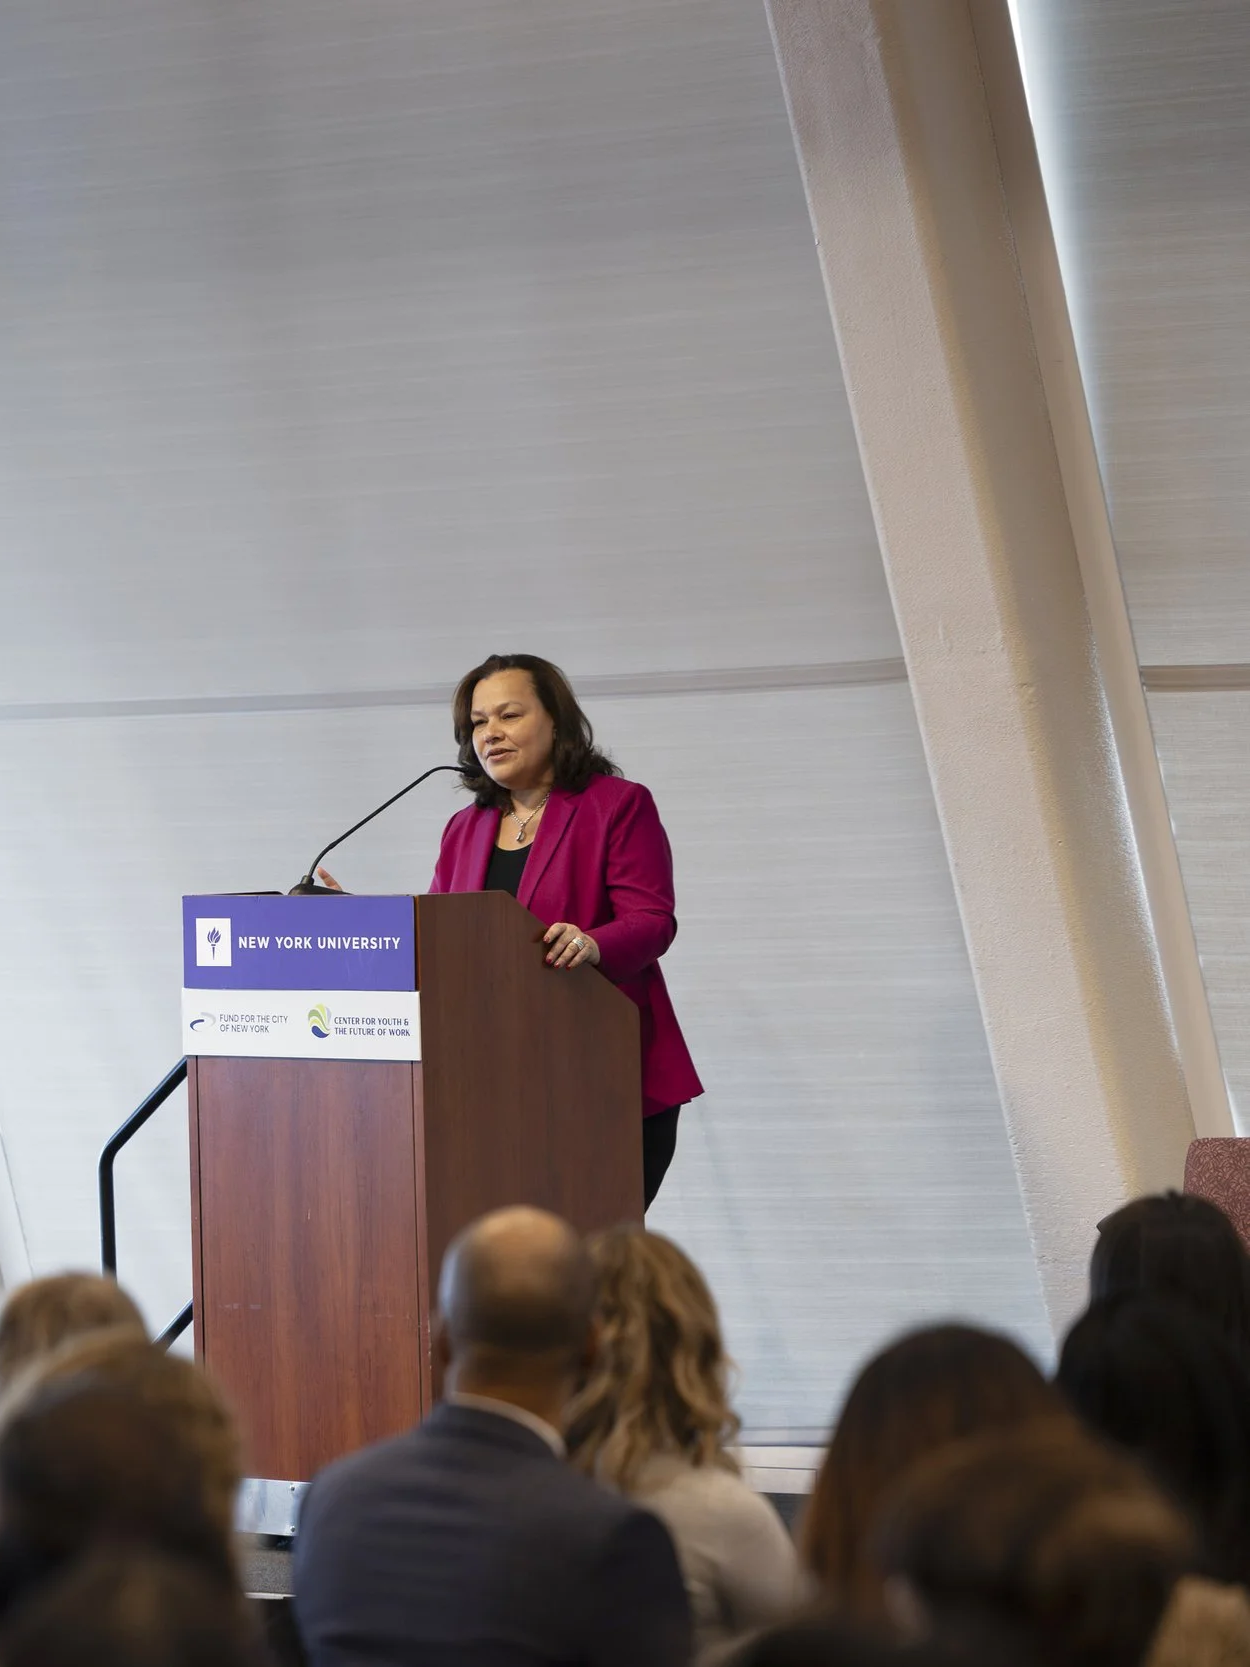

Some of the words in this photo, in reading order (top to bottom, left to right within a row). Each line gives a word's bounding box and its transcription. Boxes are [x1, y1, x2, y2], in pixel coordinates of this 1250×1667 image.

[238, 936, 270, 949] NEW
[275, 936, 312, 950] YORK
[317, 936, 401, 950] UNIVERSITY
[219, 1013, 239, 1024] FUND
[240, 1013, 256, 1024] FOR
[256, 1014, 271, 1024] THE
[271, 1014, 289, 1025] CITY
[333, 1016, 361, 1026] CENTER
[361, 1016, 377, 1026] FOR
[377, 1017, 403, 1027] YOUTH
[403, 1017, 410, 1027] &
[219, 1023, 230, 1033] OF
[231, 1023, 249, 1034] NEW
[249, 1024, 270, 1034] YORK
[334, 1027, 348, 1036] THE
[348, 1027, 376, 1036] FUTURE
[377, 1027, 387, 1037] OF
[388, 1028, 411, 1037] WORK
